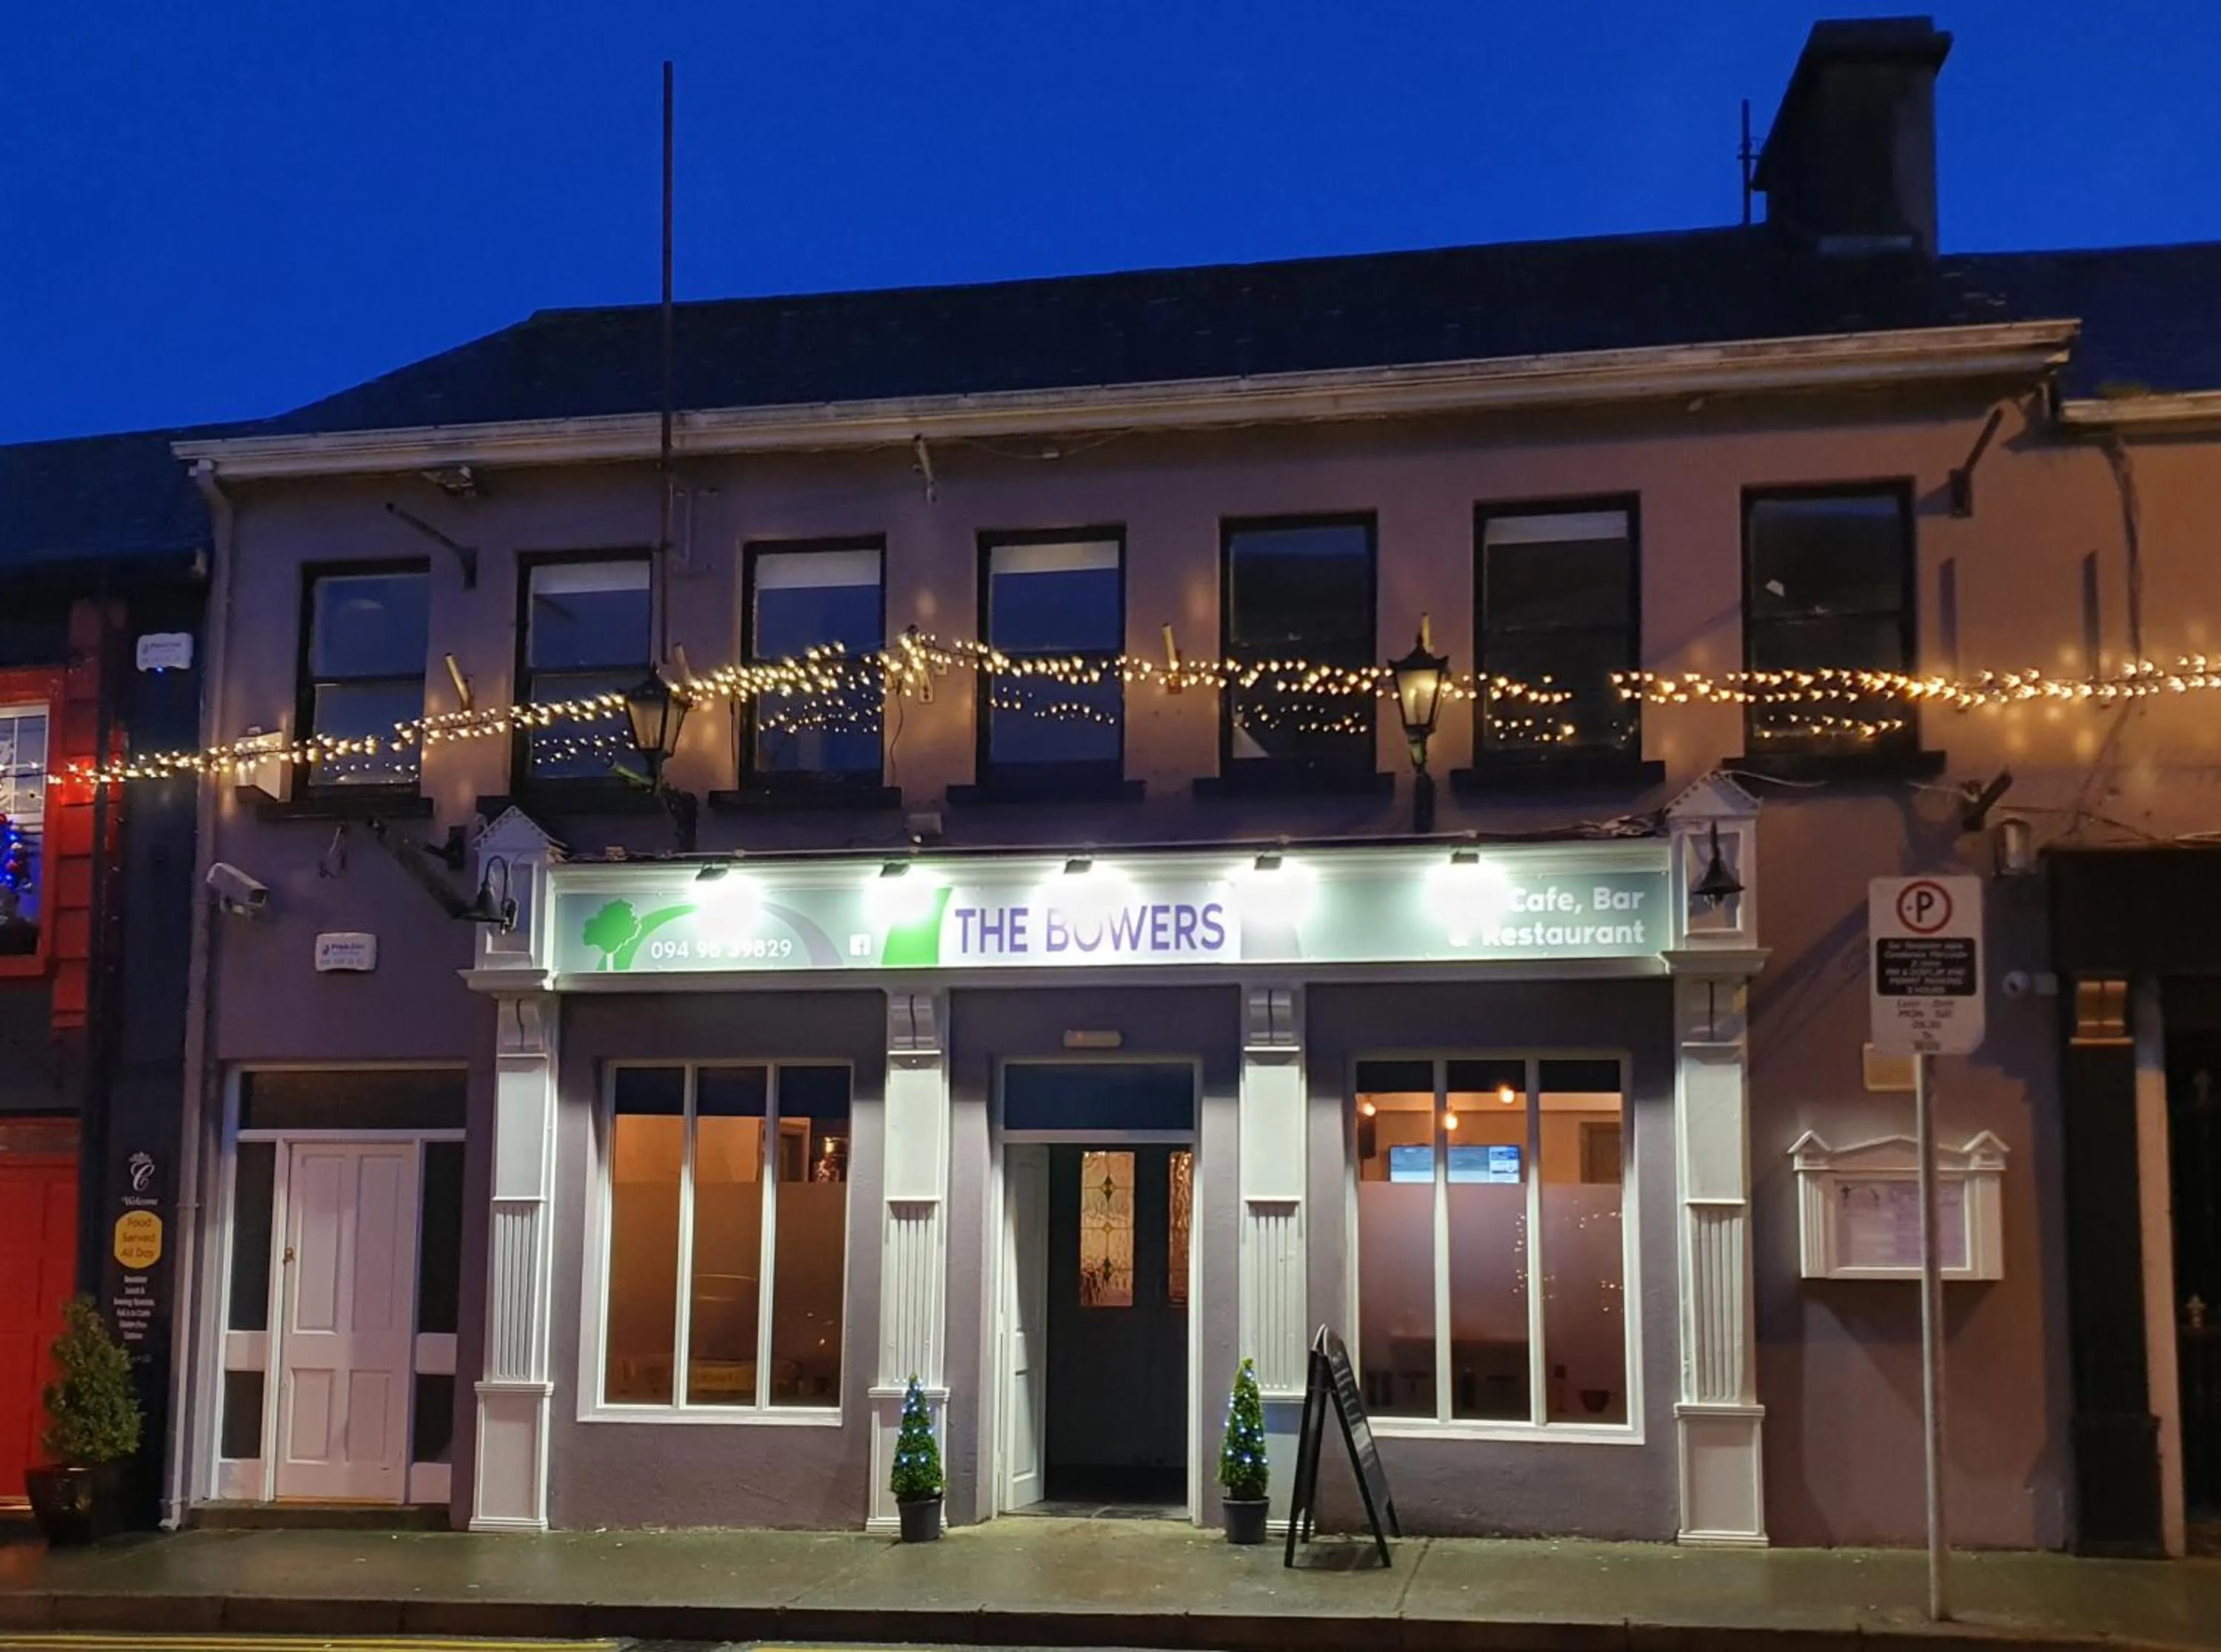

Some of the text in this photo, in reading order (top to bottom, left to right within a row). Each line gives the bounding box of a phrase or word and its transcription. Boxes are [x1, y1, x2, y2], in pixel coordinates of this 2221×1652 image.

[1509, 886, 1645, 914] Cafe, Bar
[1916, 890, 1934, 923] P
[955, 903, 1225, 953] THE BOWERS
[1481, 920, 1645, 947] Restaurant
[651, 940, 689, 959] 094
[127, 1218, 153, 1227] Food
[122, 1232, 155, 1242] Served
